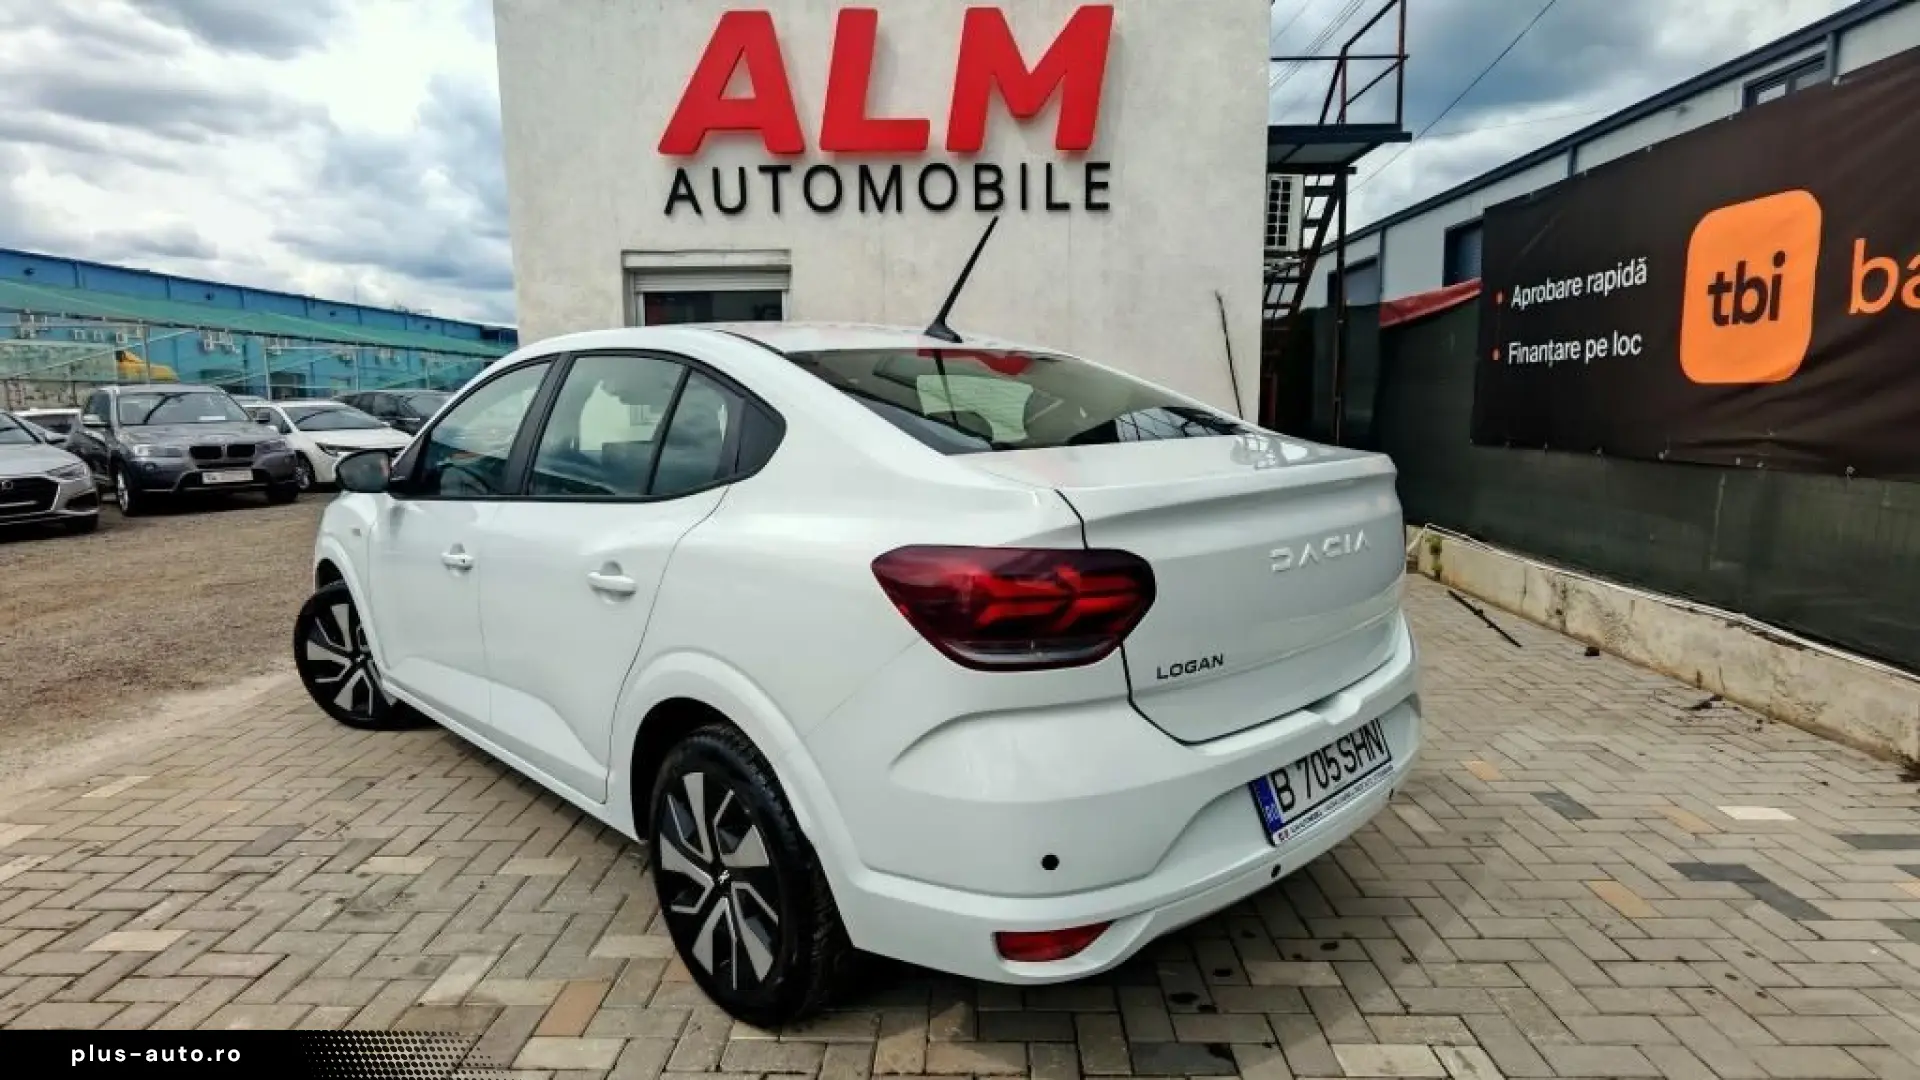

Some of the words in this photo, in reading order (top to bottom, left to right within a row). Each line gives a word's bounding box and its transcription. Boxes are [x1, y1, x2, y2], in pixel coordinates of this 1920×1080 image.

[657, 4, 1115, 155] ALM
[664, 162, 1111, 216] AUTOMOBILE
[1510, 276, 1582, 311] Aprobare
[1586, 257, 1648, 296] rapidă
[1707, 250, 1788, 327] tbi
[1507, 336, 1581, 368] Finanțare
[1585, 337, 1608, 364] pe
[1612, 330, 1643, 357] loc
[1268, 529, 1370, 573] DACIA
[1156, 653, 1225, 680] LOGAN
[1270, 768, 1296, 813] B
[1296, 746, 1342, 800] 705
[1338, 718, 1386, 774] SHN
